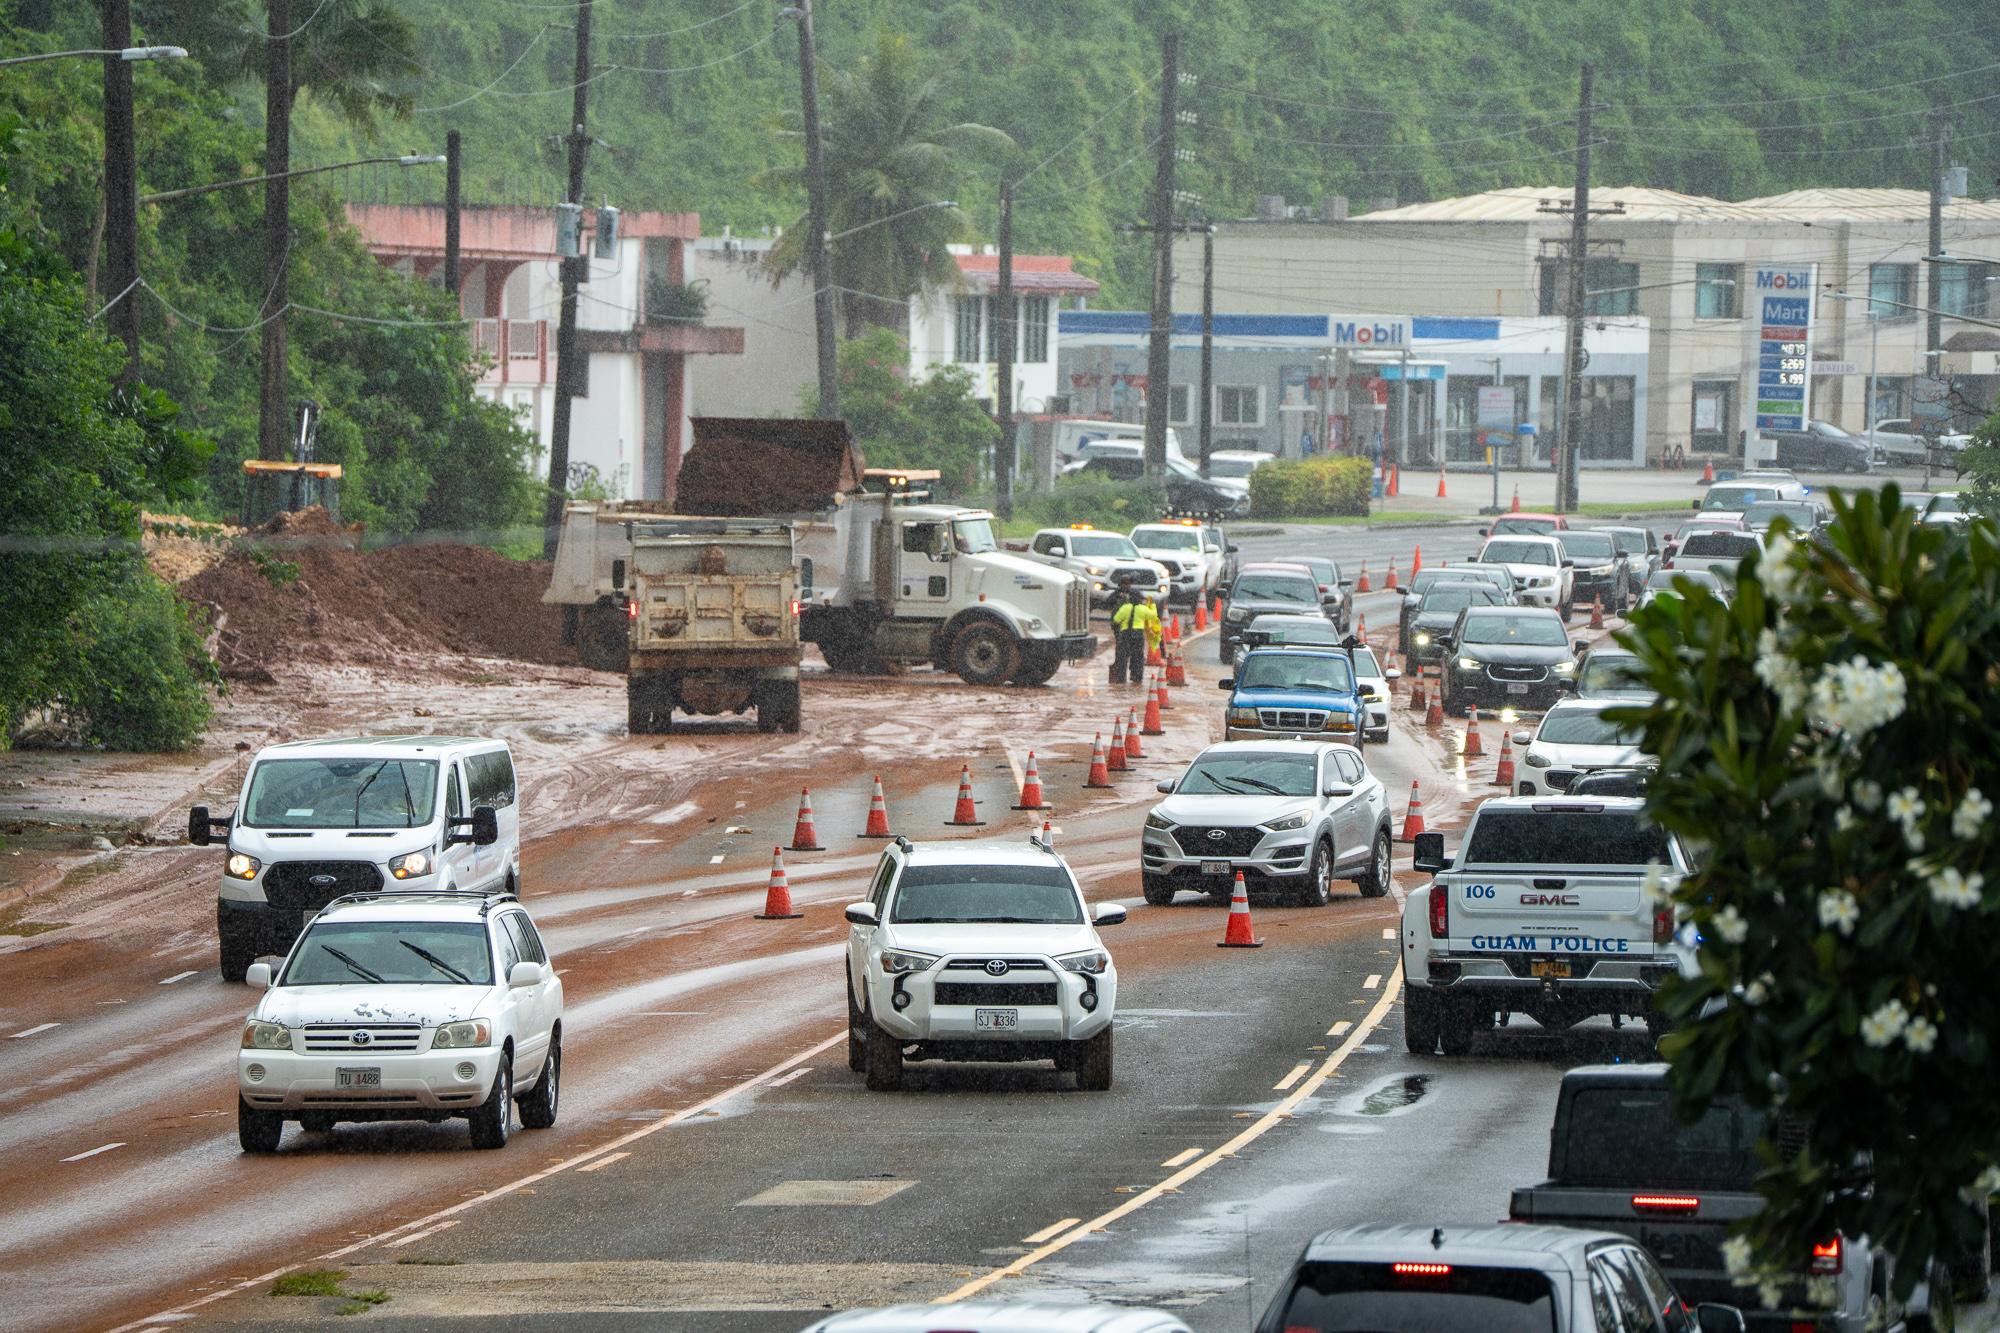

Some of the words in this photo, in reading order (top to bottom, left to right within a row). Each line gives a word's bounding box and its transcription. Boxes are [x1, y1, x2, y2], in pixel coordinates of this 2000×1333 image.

[1757, 270, 1808, 289] Mobil
[1765, 303, 1806, 320] Mart
[1336, 322, 1402, 343] Mobil
[1465, 884, 1496, 899] 106
[1520, 894, 1580, 906] GMC
[1471, 935, 1537, 951] GUAM
[1550, 936, 1629, 952] POLICE
[978, 1015, 989, 1027] SJ
[339, 1073, 351, 1085] TU
[356, 1073, 379, 1085] 1488
